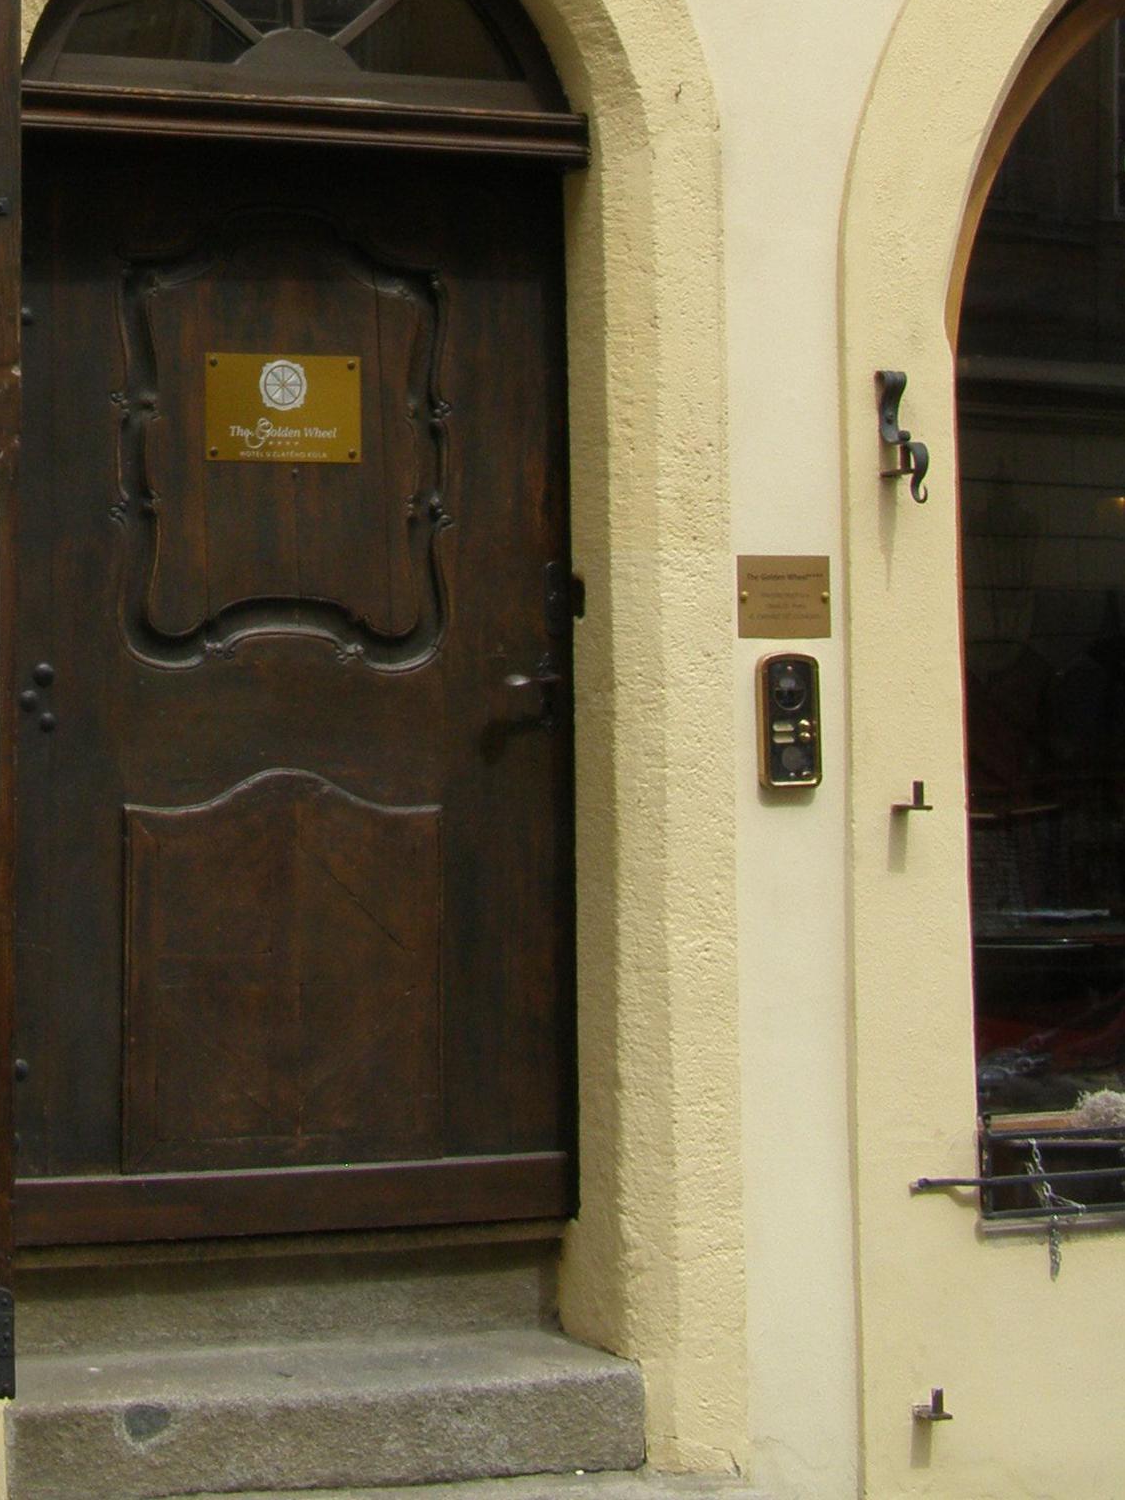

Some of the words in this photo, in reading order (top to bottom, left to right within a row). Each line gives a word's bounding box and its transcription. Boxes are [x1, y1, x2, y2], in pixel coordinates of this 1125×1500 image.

[229, 425, 253, 438] The
[248, 417, 301, 446] Golden
[304, 427, 338, 439] Wheel
